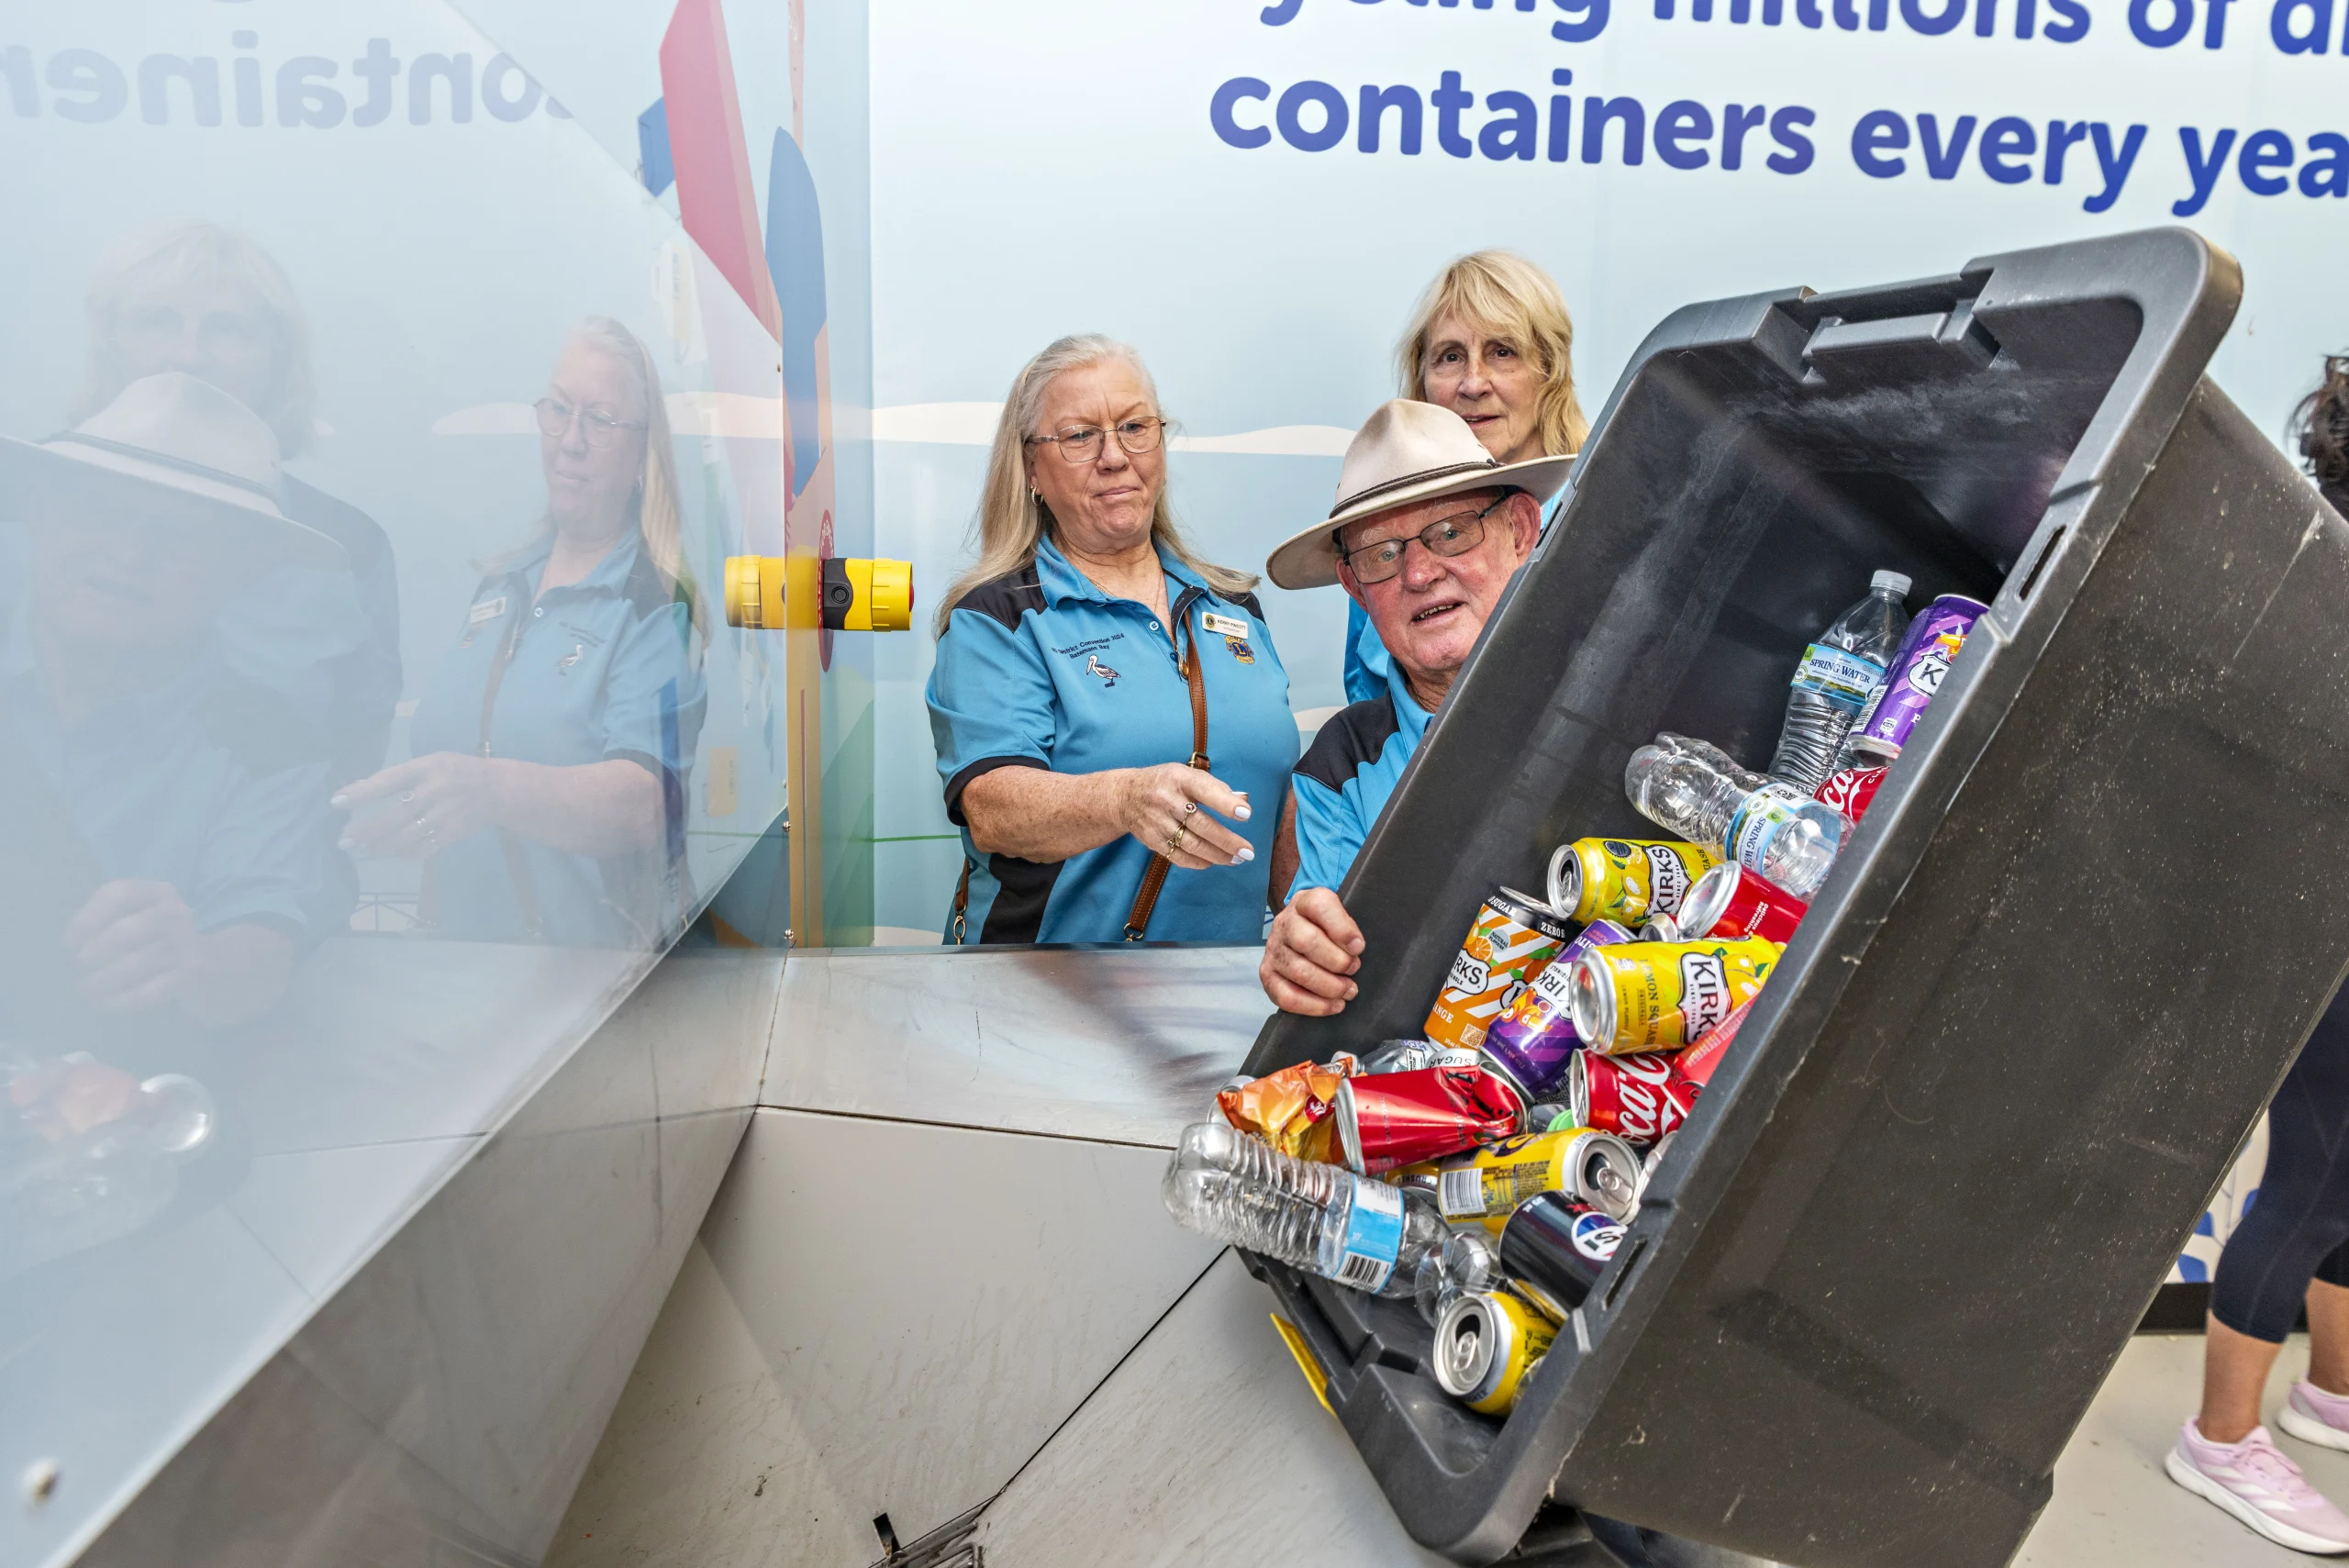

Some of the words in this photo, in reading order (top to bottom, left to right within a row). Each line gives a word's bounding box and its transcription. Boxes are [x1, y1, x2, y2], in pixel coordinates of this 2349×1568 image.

[1209, 68, 1816, 175] containers
[1849, 107, 2146, 214] every
[2170, 126, 2349, 217] yea
[1079, 638, 1110, 648] Convention
[1810, 658, 1840, 673] SPRING
[1841, 665, 1871, 684] WATER
[1746, 817, 1766, 849] SPRING
[1652, 848, 1675, 914] KIRKS
[1491, 896, 1517, 917] SUGAR
[1743, 901, 1765, 932] Refreshing
[1752, 903, 1769, 930] Delicious
[1491, 931, 1509, 948] NATURAL
[1541, 921, 1560, 937] ZERO
[1639, 959, 1658, 1001] LEMON
